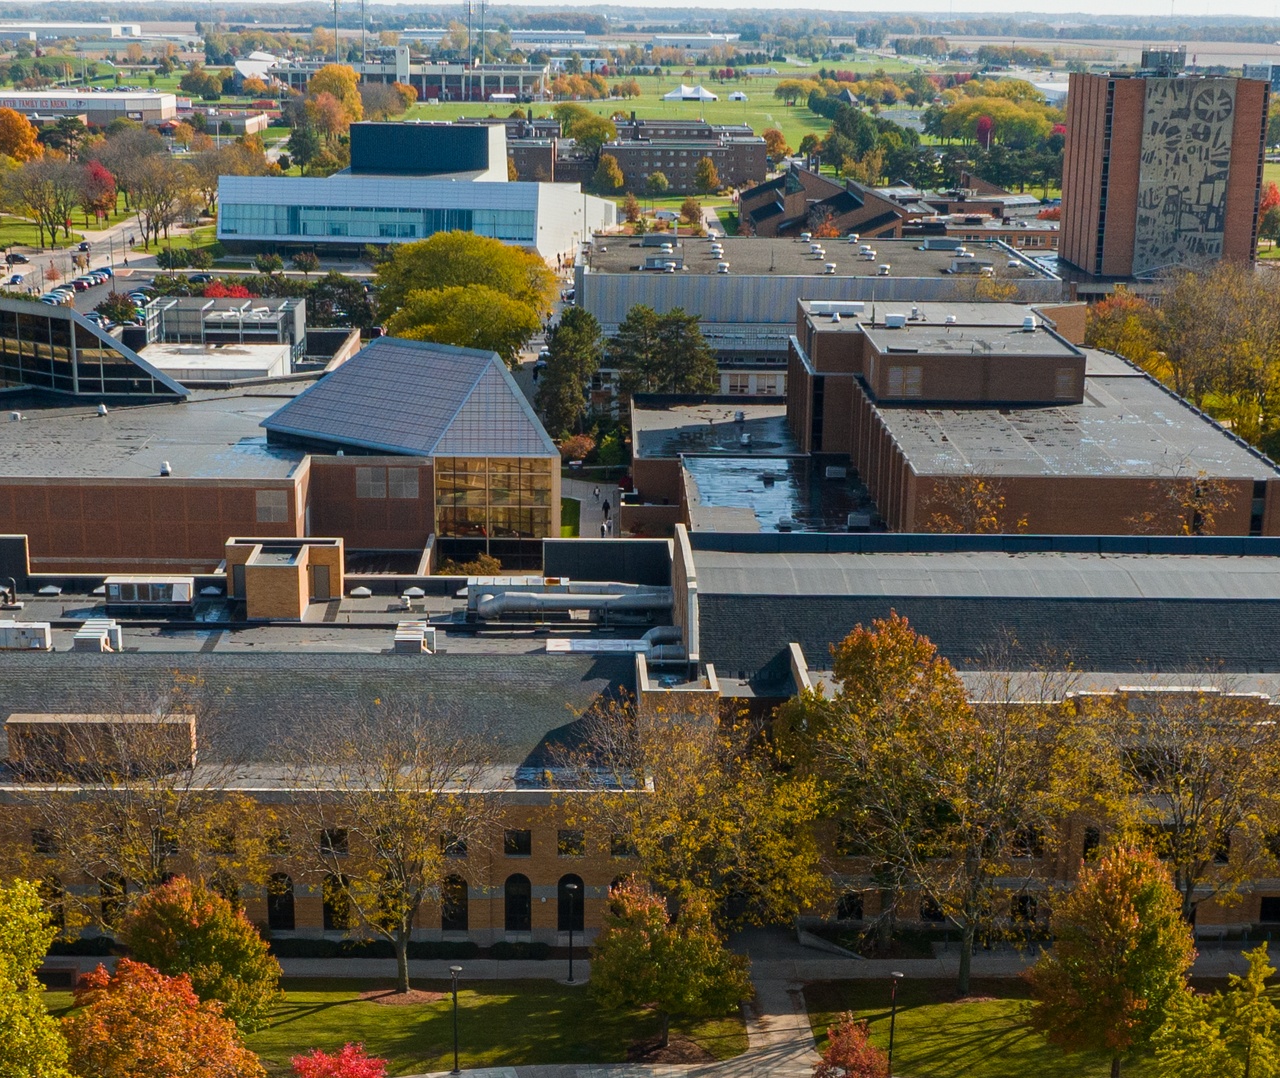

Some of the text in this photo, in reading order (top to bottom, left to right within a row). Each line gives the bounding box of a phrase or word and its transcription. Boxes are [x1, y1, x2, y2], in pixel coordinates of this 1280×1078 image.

[19, 99, 38, 108] FAMILY
[40, 99, 49, 108] ICE
[50, 99, 68, 108] ARENA
